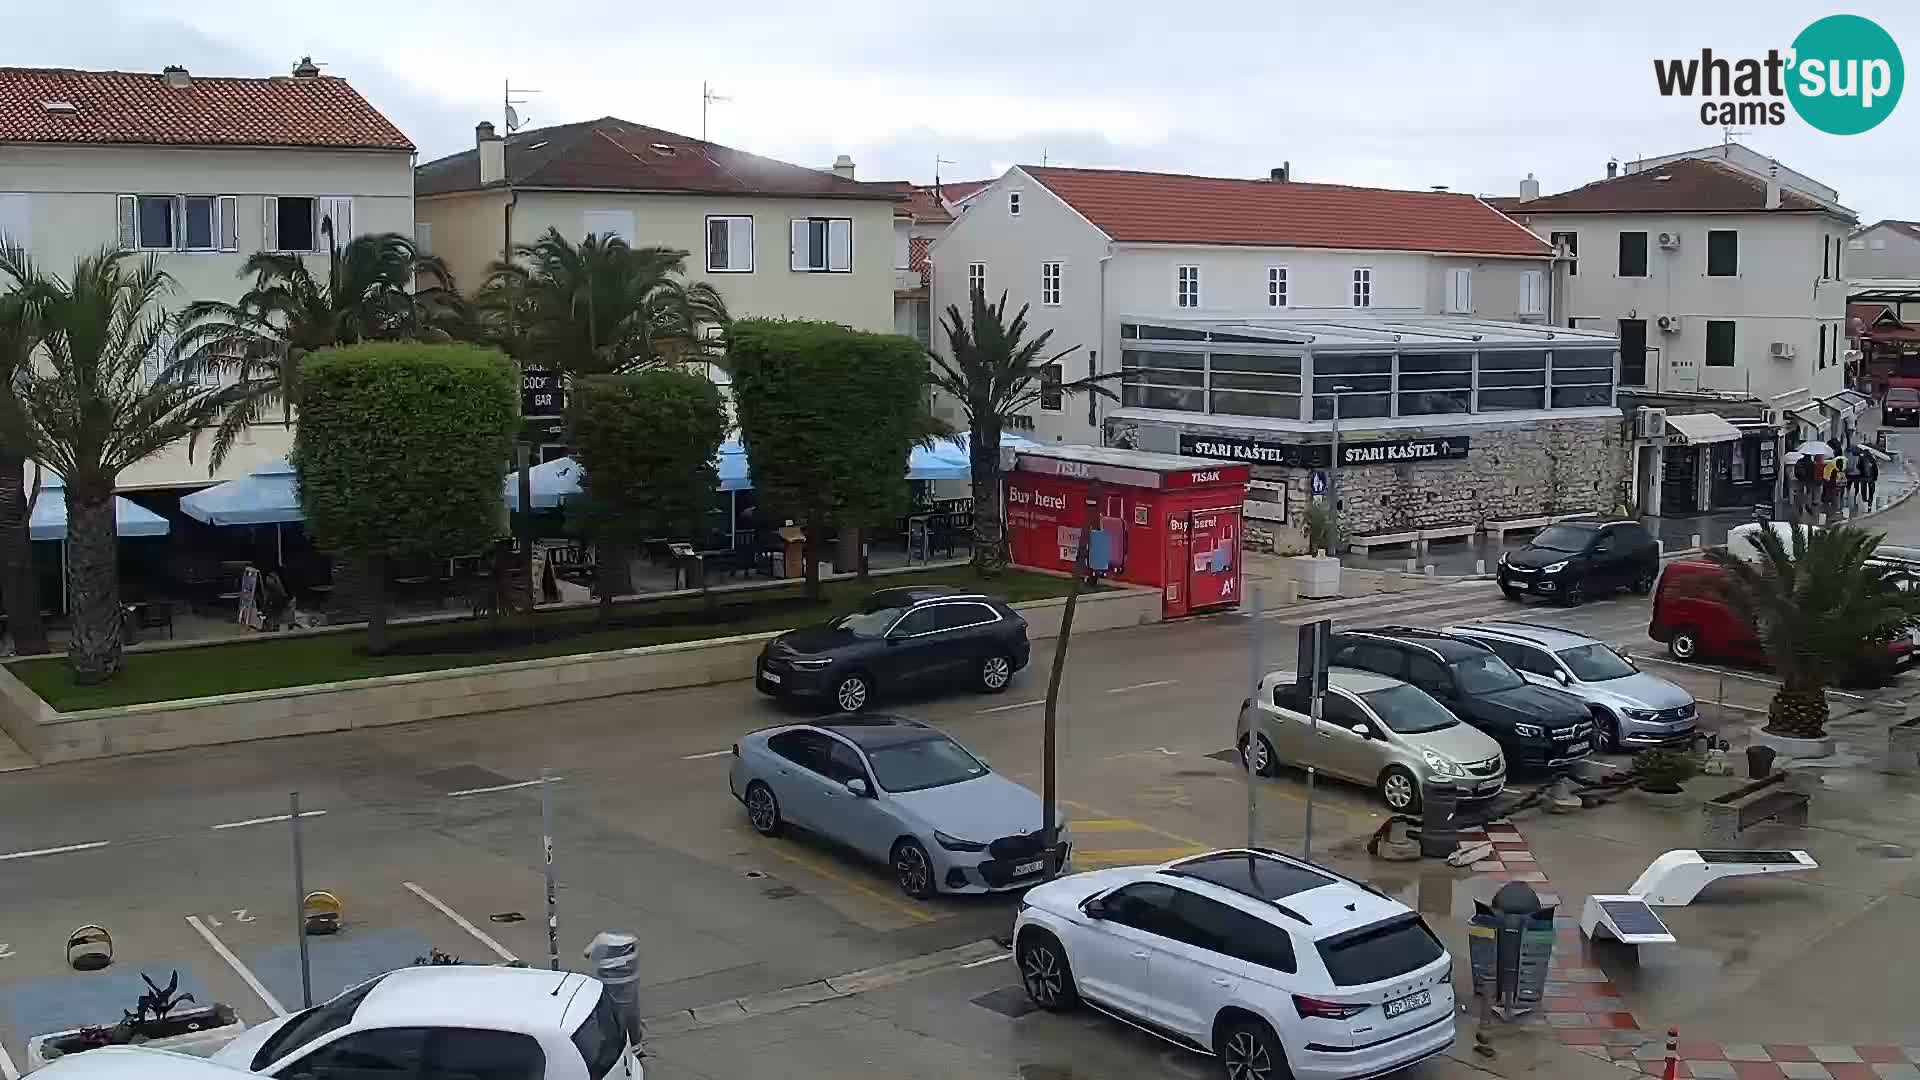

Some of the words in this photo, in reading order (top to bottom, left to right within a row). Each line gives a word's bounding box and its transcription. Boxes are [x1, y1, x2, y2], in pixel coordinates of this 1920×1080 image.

[523, 376, 563, 389] COCKL
[1195, 441, 1231, 457] STARI
[1233, 443, 1283, 462] KAŠTEL
[1345, 445, 1385, 462] STARI
[1388, 441, 1438, 458] KAŠTEL
[1192, 471, 1220, 483] TISAK
[1009, 486, 1030, 504] Buy
[1035, 490, 1066, 510] here!
[1170, 519, 1189, 532] Buy
[1194, 516, 1217, 529] here!
